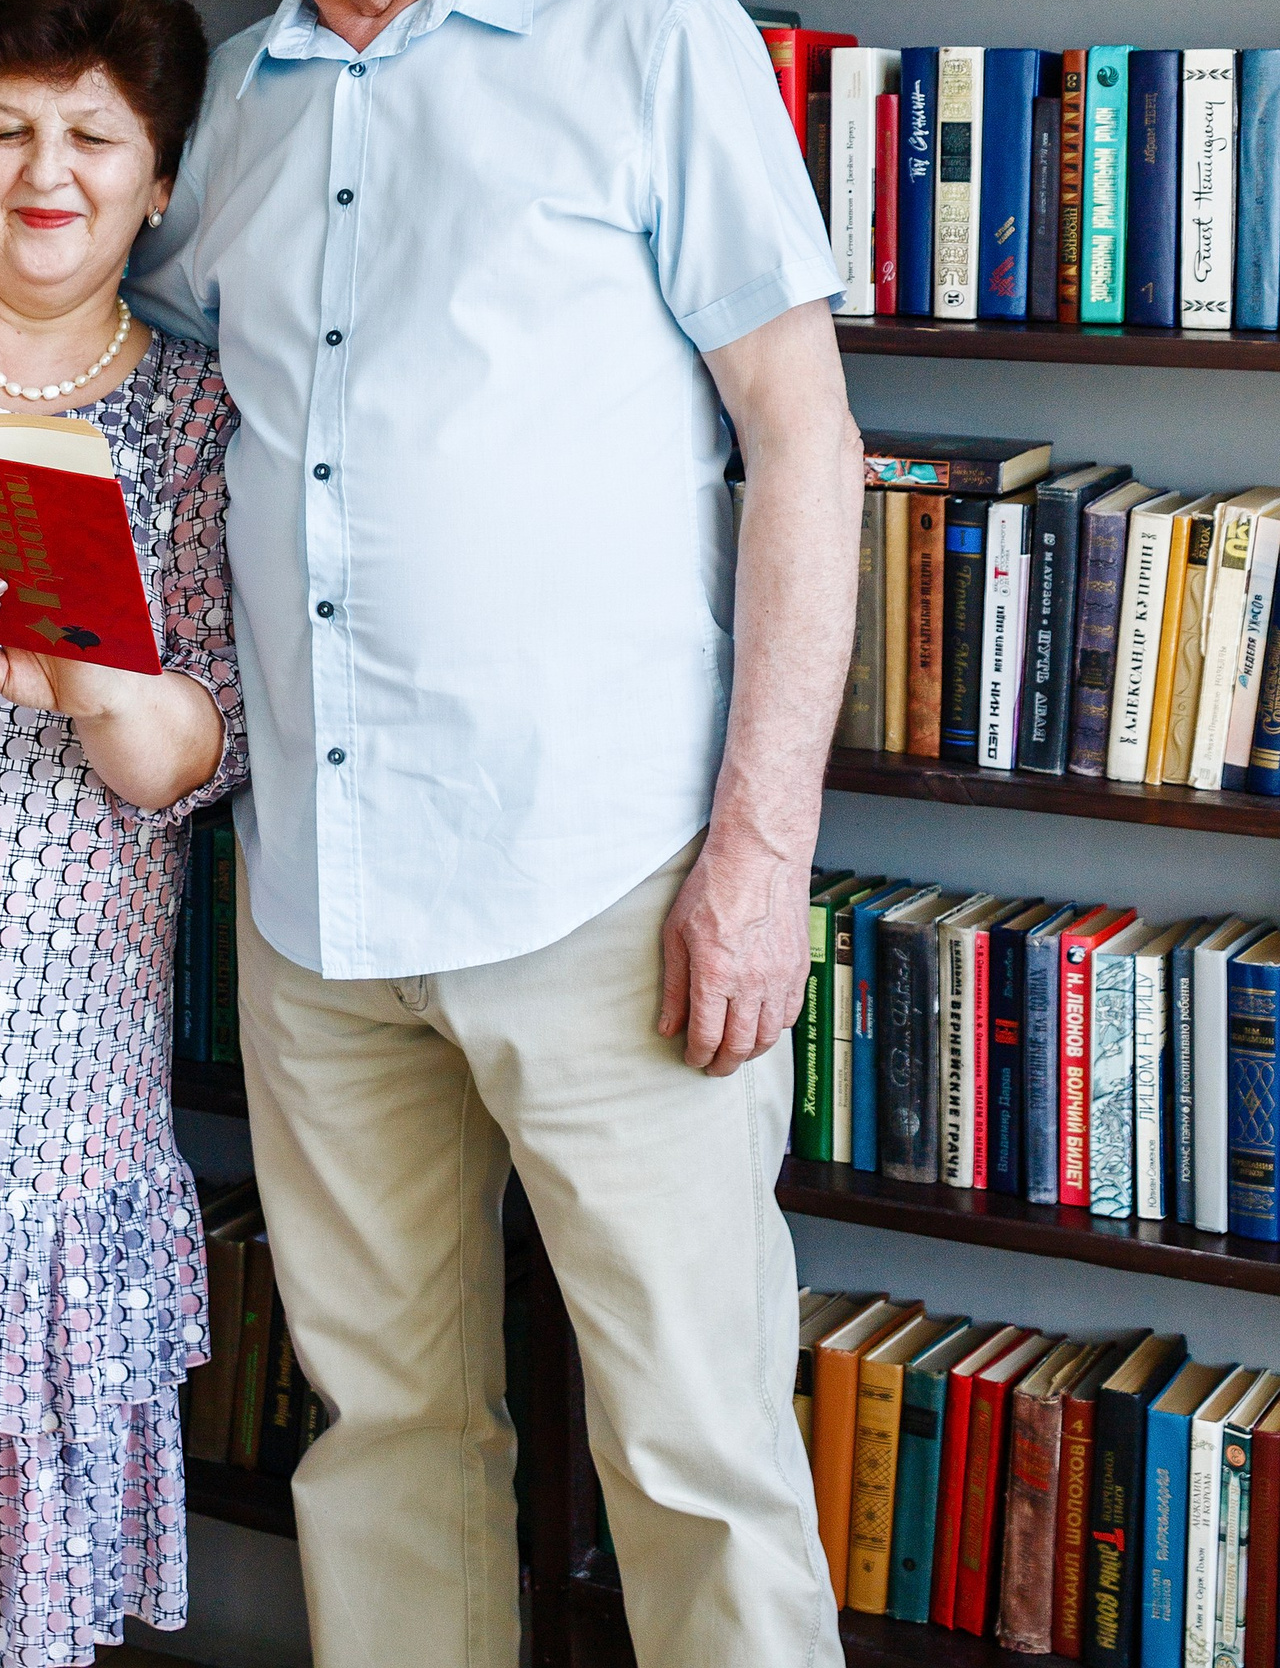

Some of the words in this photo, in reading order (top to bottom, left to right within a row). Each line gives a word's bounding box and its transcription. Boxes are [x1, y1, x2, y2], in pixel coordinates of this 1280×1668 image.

[1192, 101, 1228, 210] Hemingway
[1192, 216, 1214, 283] Ernest
[1133, 544, 1154, 622] КУПРИН
[989, 681, 1002, 718] КИН
[1123, 628, 1147, 734] АЛЕКСАНДР
[987, 722, 1000, 761] ДЭЙ
[805, 975, 820, 1024] понять
[1067, 972, 1083, 988] Н.
[1136, 972, 1155, 1025] ЛИЦУ
[1178, 977, 1191, 1022] ребенка
[807, 1025, 818, 1041] не
[1066, 990, 1083, 1058] ЛЕОНОВ
[803, 1042, 820, 1117] Женщинам
[949, 999, 964, 1118] ВЕРНЕЙСКИЕ
[1179, 1024, 1192, 1094] воспитываю
[1066, 1066, 1088, 1133] ВОЛЧИЙ
[1137, 1054, 1156, 1125] ЛИЦОМ
[947, 1122, 962, 1178] ГРАЧИ
[1066, 1135, 1083, 1190] БИЛЕТ
[1192, 1471, 1202, 1530] АНЖЕЛИКА
[1202, 1473, 1213, 1515] КОРОЛЬ
